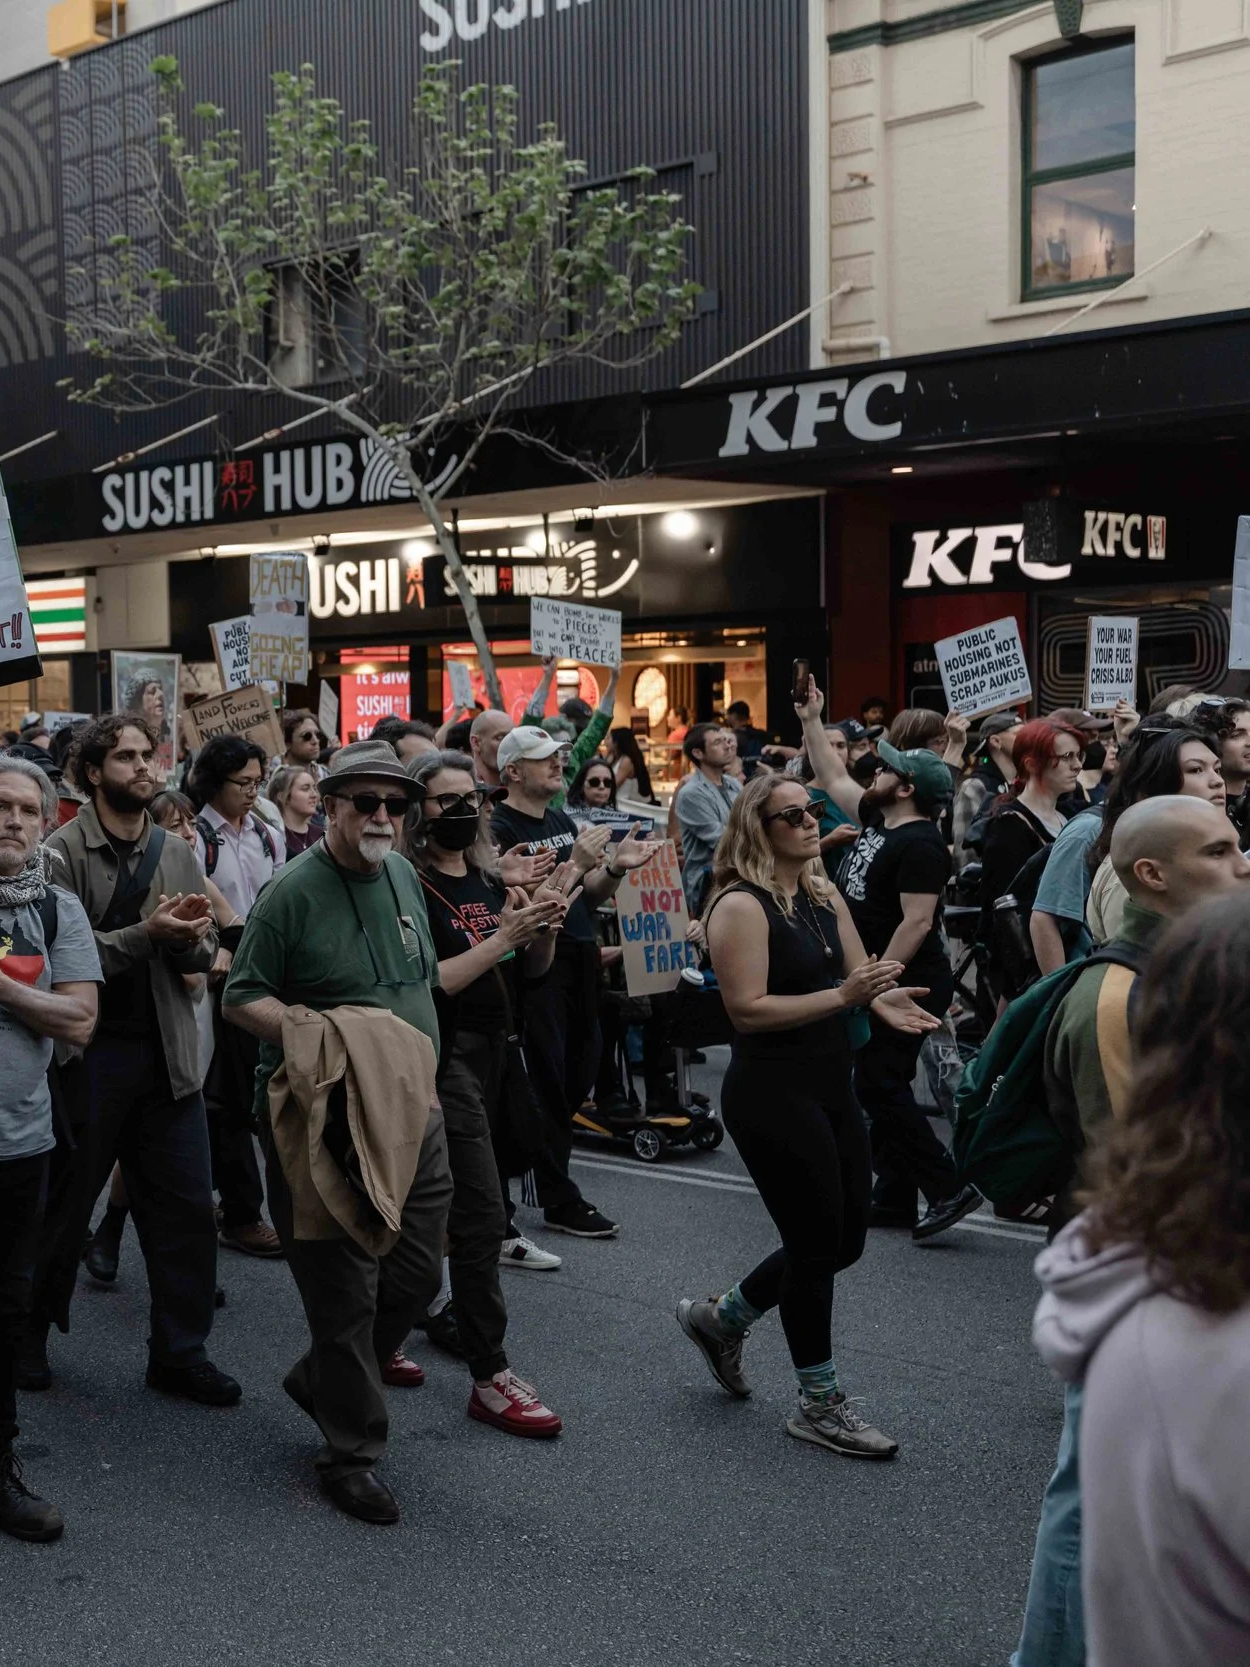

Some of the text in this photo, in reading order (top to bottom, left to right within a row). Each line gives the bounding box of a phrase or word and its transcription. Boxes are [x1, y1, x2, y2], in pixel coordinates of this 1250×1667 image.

[719, 371, 907, 458] KFC
[101, 441, 355, 532] SUSHI HUB
[1081, 510, 1143, 560] KFC
[251, 559, 305, 599] DEATH
[308, 557, 400, 619] USHI
[444, 564, 549, 597] SSHI HUB
[533, 601, 543, 612] WE
[547, 604, 560, 615] CAN
[224, 625, 250, 640] PUBL
[565, 618, 598, 635] PIECES
[1096, 627, 1133, 644] YOUR WAR
[222, 636, 250, 651] HOUS
[251, 633, 305, 655] GOING
[957, 628, 996, 652] PUBLIC
[235, 645, 250, 657] NO
[568, 644, 607, 663] PEACE
[944, 637, 1017, 673] HOUSING NOT
[1095, 648, 1132, 664] YOUR FUEL
[232, 656, 250, 669] AUK
[251, 653, 304, 684] CHEAP
[950, 653, 1020, 688] SUBMARINES
[230, 669, 247, 682] CUT
[950, 681, 987, 703] SCRAP
[989, 667, 1026, 690] AUKUS
[1091, 667, 1134, 685] CRISIS ALBO
[192, 706, 220, 726] LAND
[356, 695, 393, 716] SUSHI
[200, 724, 225, 742] NOT
[629, 868, 675, 888] CARE
[459, 902, 490, 917] FREE
[640, 888, 683, 913] NOT
[621, 911, 672, 942] WAR
[644, 940, 696, 974] FARE
